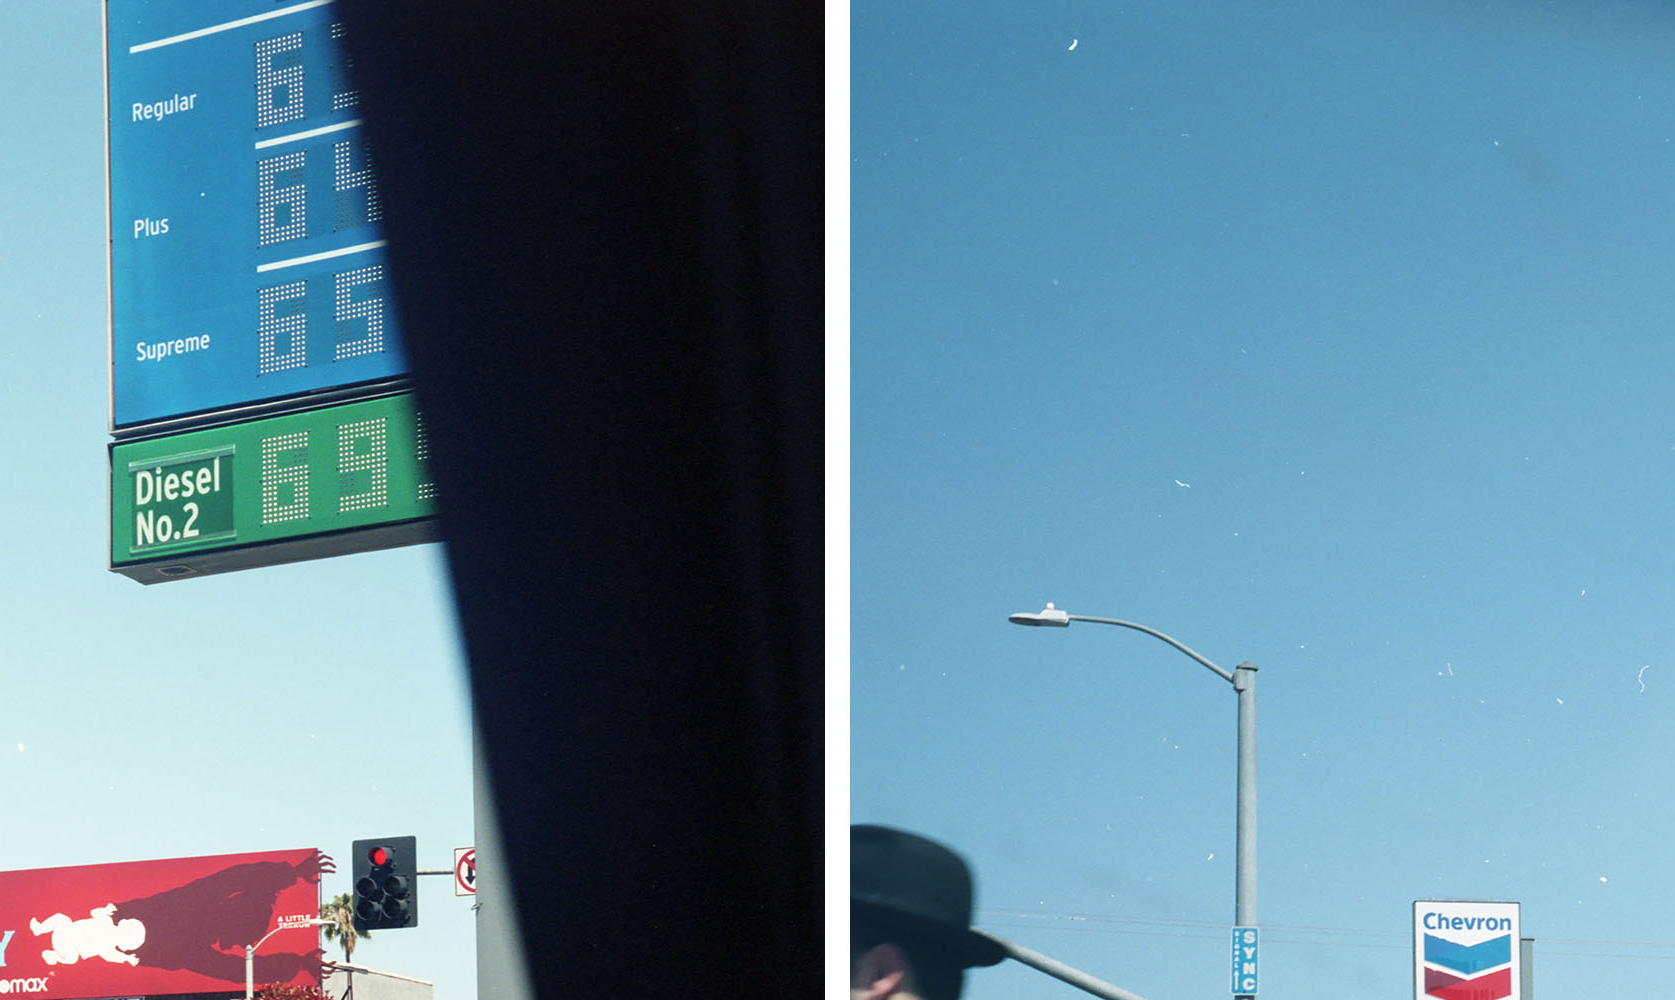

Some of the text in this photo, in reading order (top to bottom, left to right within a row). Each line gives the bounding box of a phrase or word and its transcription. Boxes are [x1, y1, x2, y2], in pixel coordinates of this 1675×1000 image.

[132, 90, 197, 122] Regular
[134, 215, 169, 239] Plus
[136, 331, 210, 363] Supreme
[136, 459, 220, 505] Diesel
[136, 502, 199, 547] No.2
[1423, 912, 1512, 931] Chevron
[1242, 931, 1255, 990] SYNC
